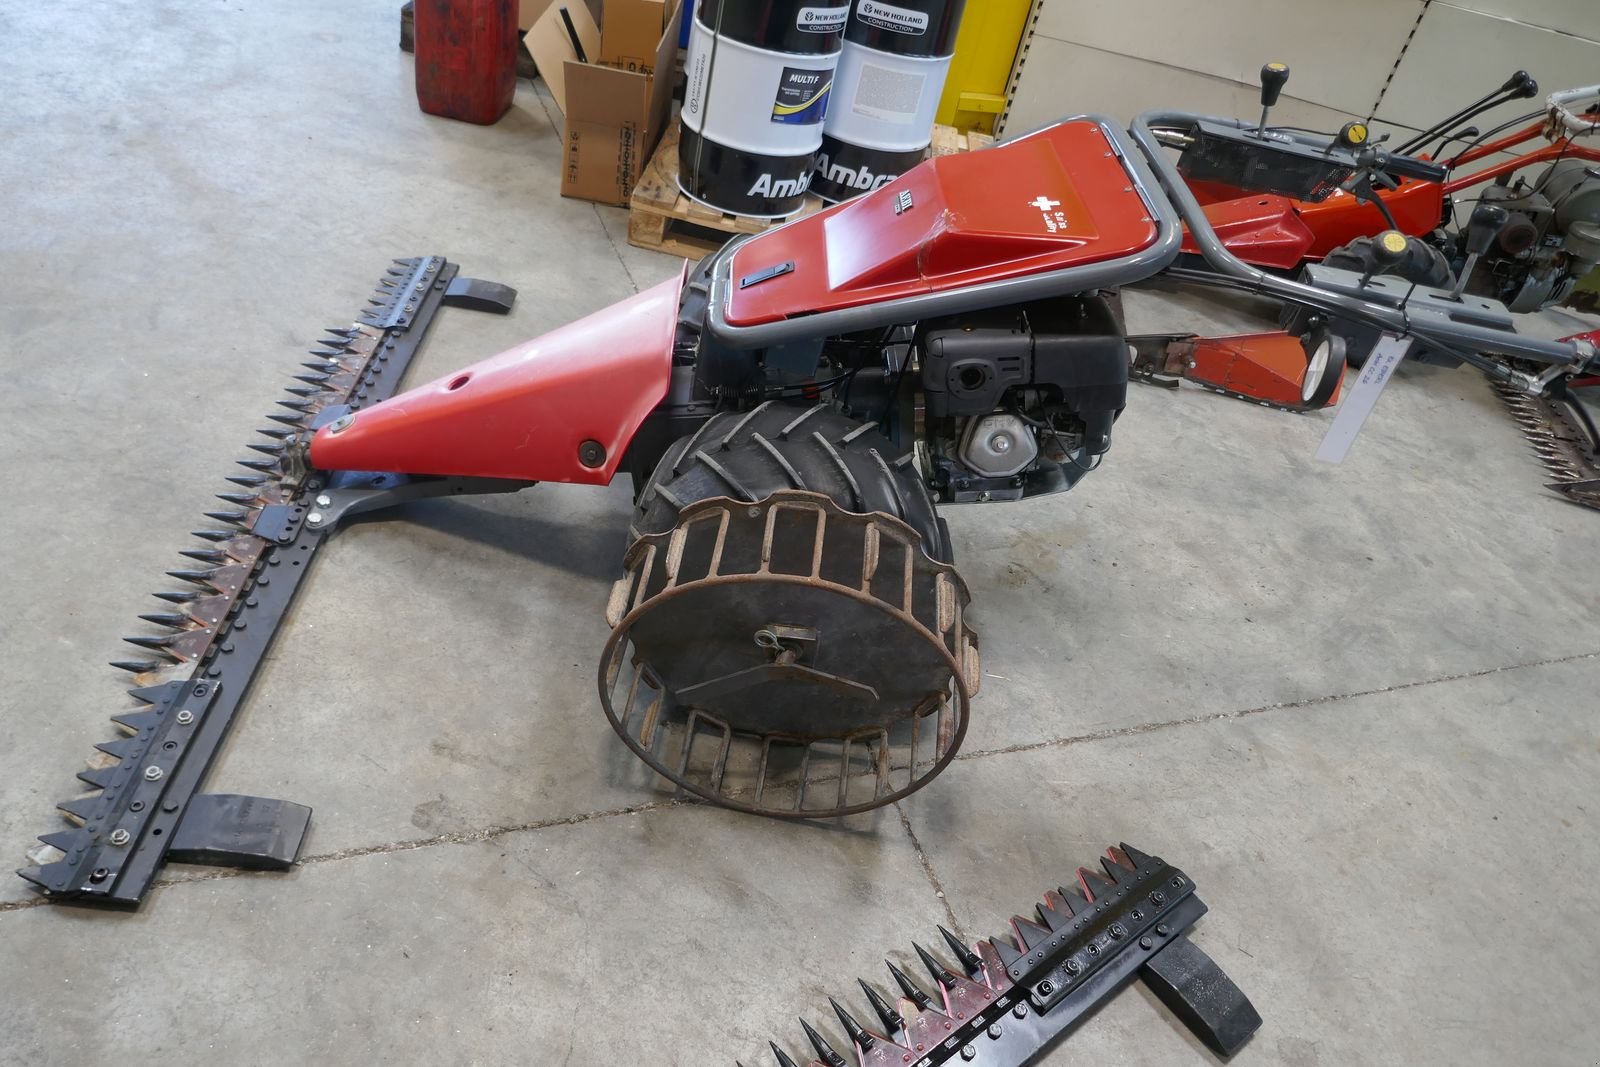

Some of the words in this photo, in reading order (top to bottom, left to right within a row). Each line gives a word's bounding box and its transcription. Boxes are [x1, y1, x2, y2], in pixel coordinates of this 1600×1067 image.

[868, 17, 913, 32] CONSTRUCTION
[874, 8, 890, 18] NEW
[891, 12, 923, 25] HOLLAND
